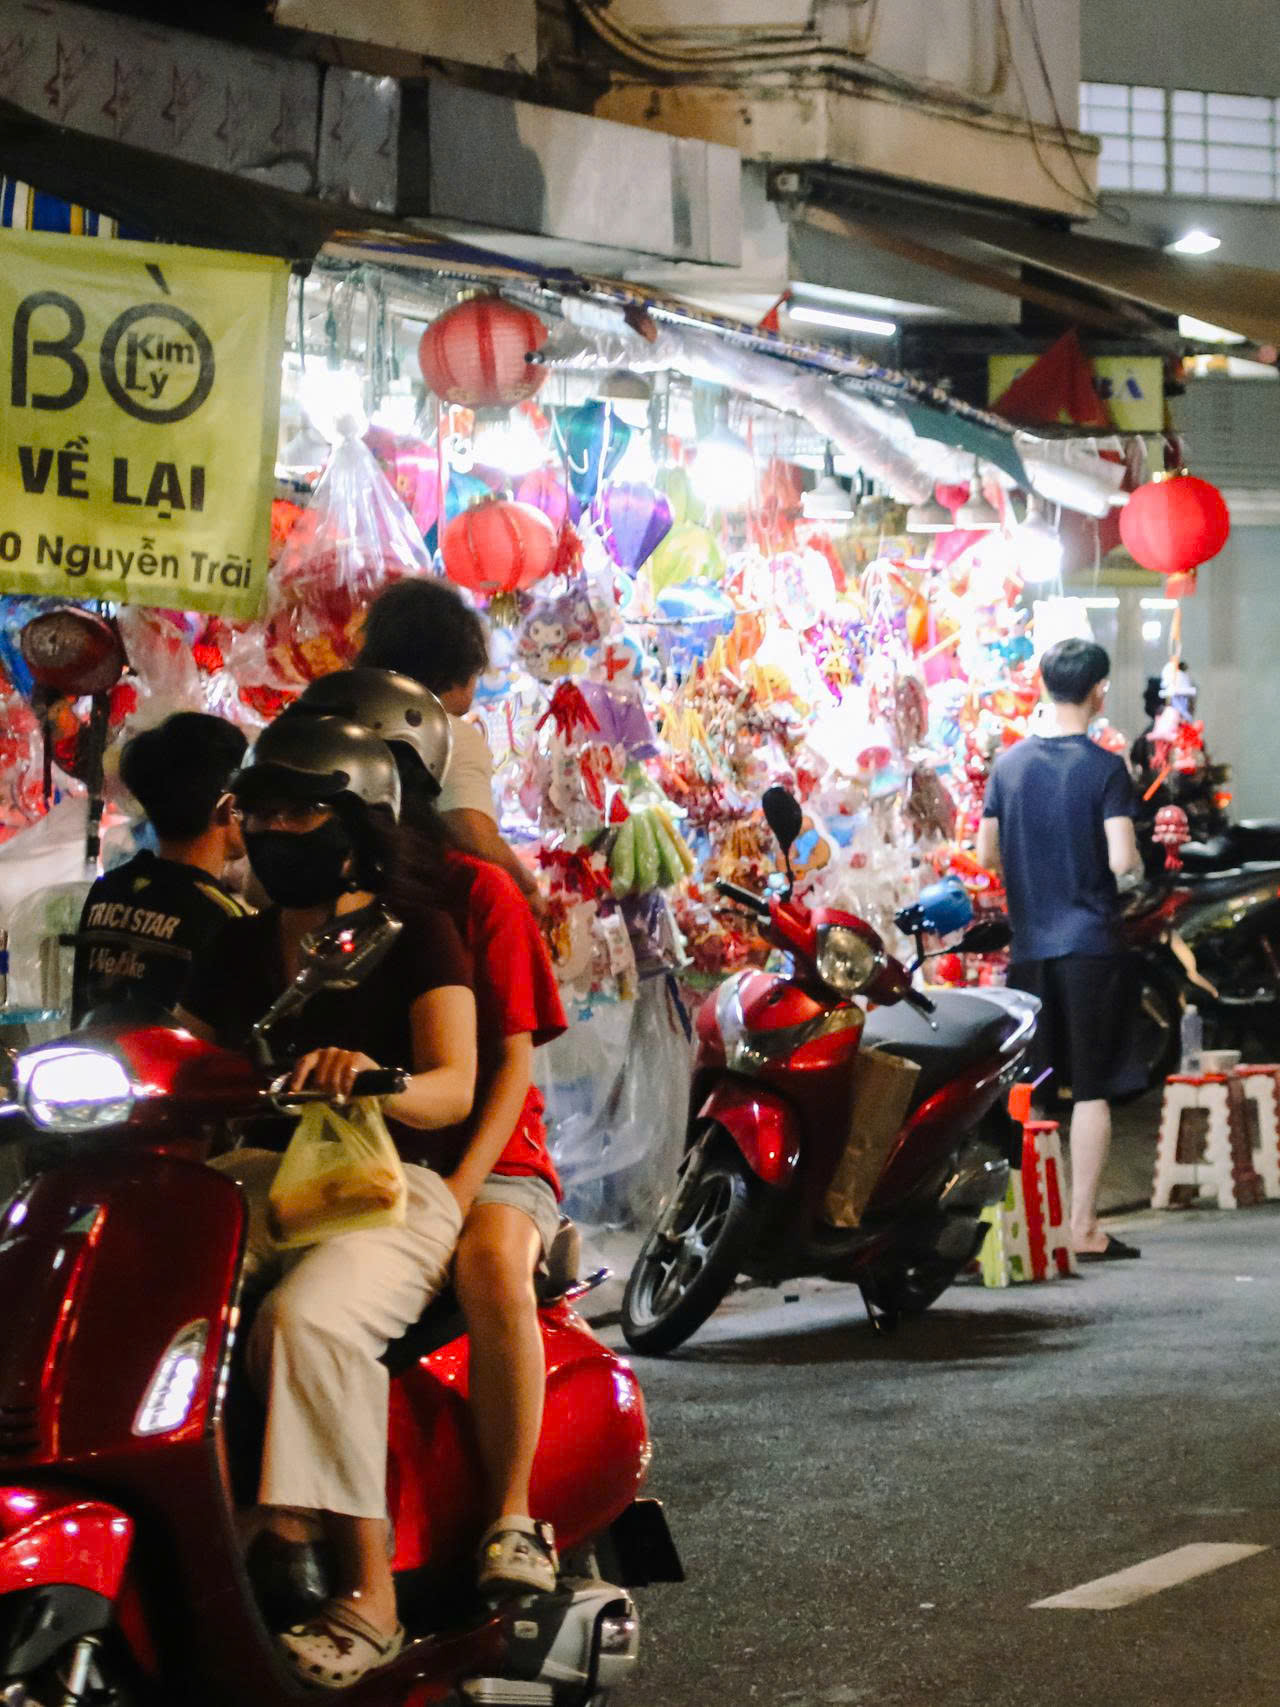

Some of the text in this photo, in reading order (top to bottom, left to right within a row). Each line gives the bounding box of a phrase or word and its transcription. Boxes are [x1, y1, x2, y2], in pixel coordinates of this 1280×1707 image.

[126, 332, 195, 364] Kim
[18, 435, 206, 519] VỀ LẠI
[36, 533, 180, 579] Nguyễn
[190, 550, 253, 588] Trãi
